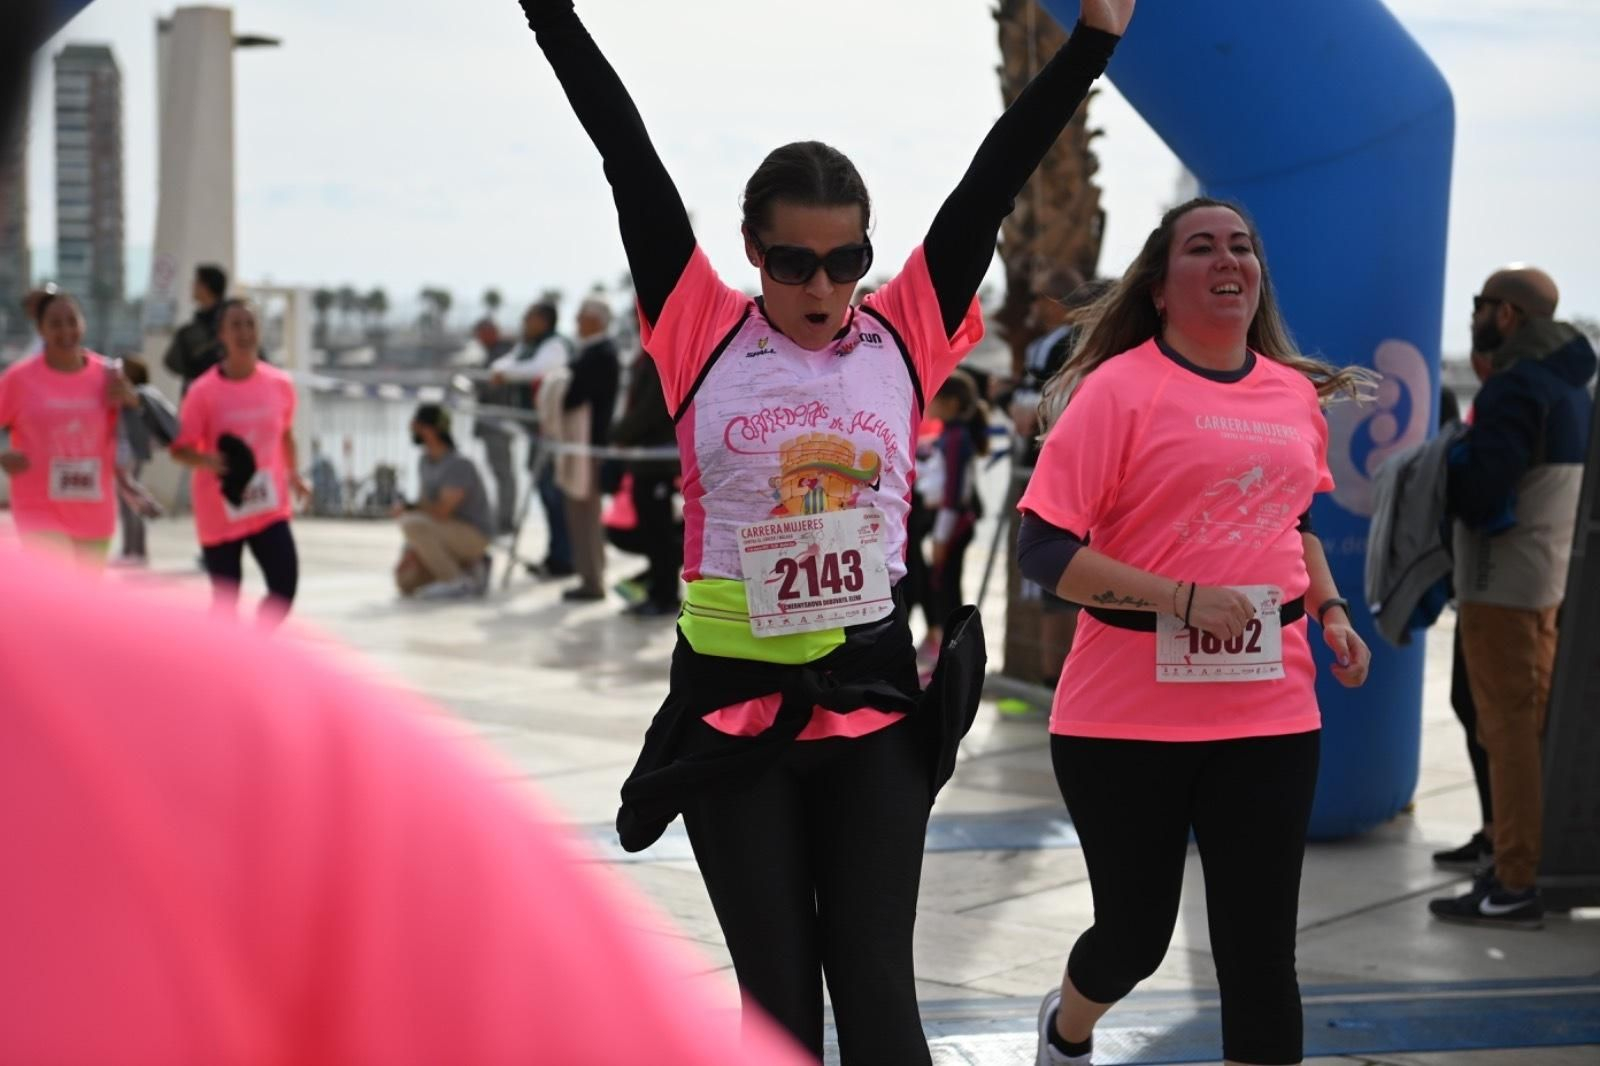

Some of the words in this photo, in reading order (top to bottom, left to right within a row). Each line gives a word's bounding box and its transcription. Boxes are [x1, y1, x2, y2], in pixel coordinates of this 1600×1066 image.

[1195, 415, 1249, 433] CARRERA
[741, 524, 783, 539] CARRERA
[783, 518, 824, 533] MUJERES
[775, 549, 864, 601] 2143
